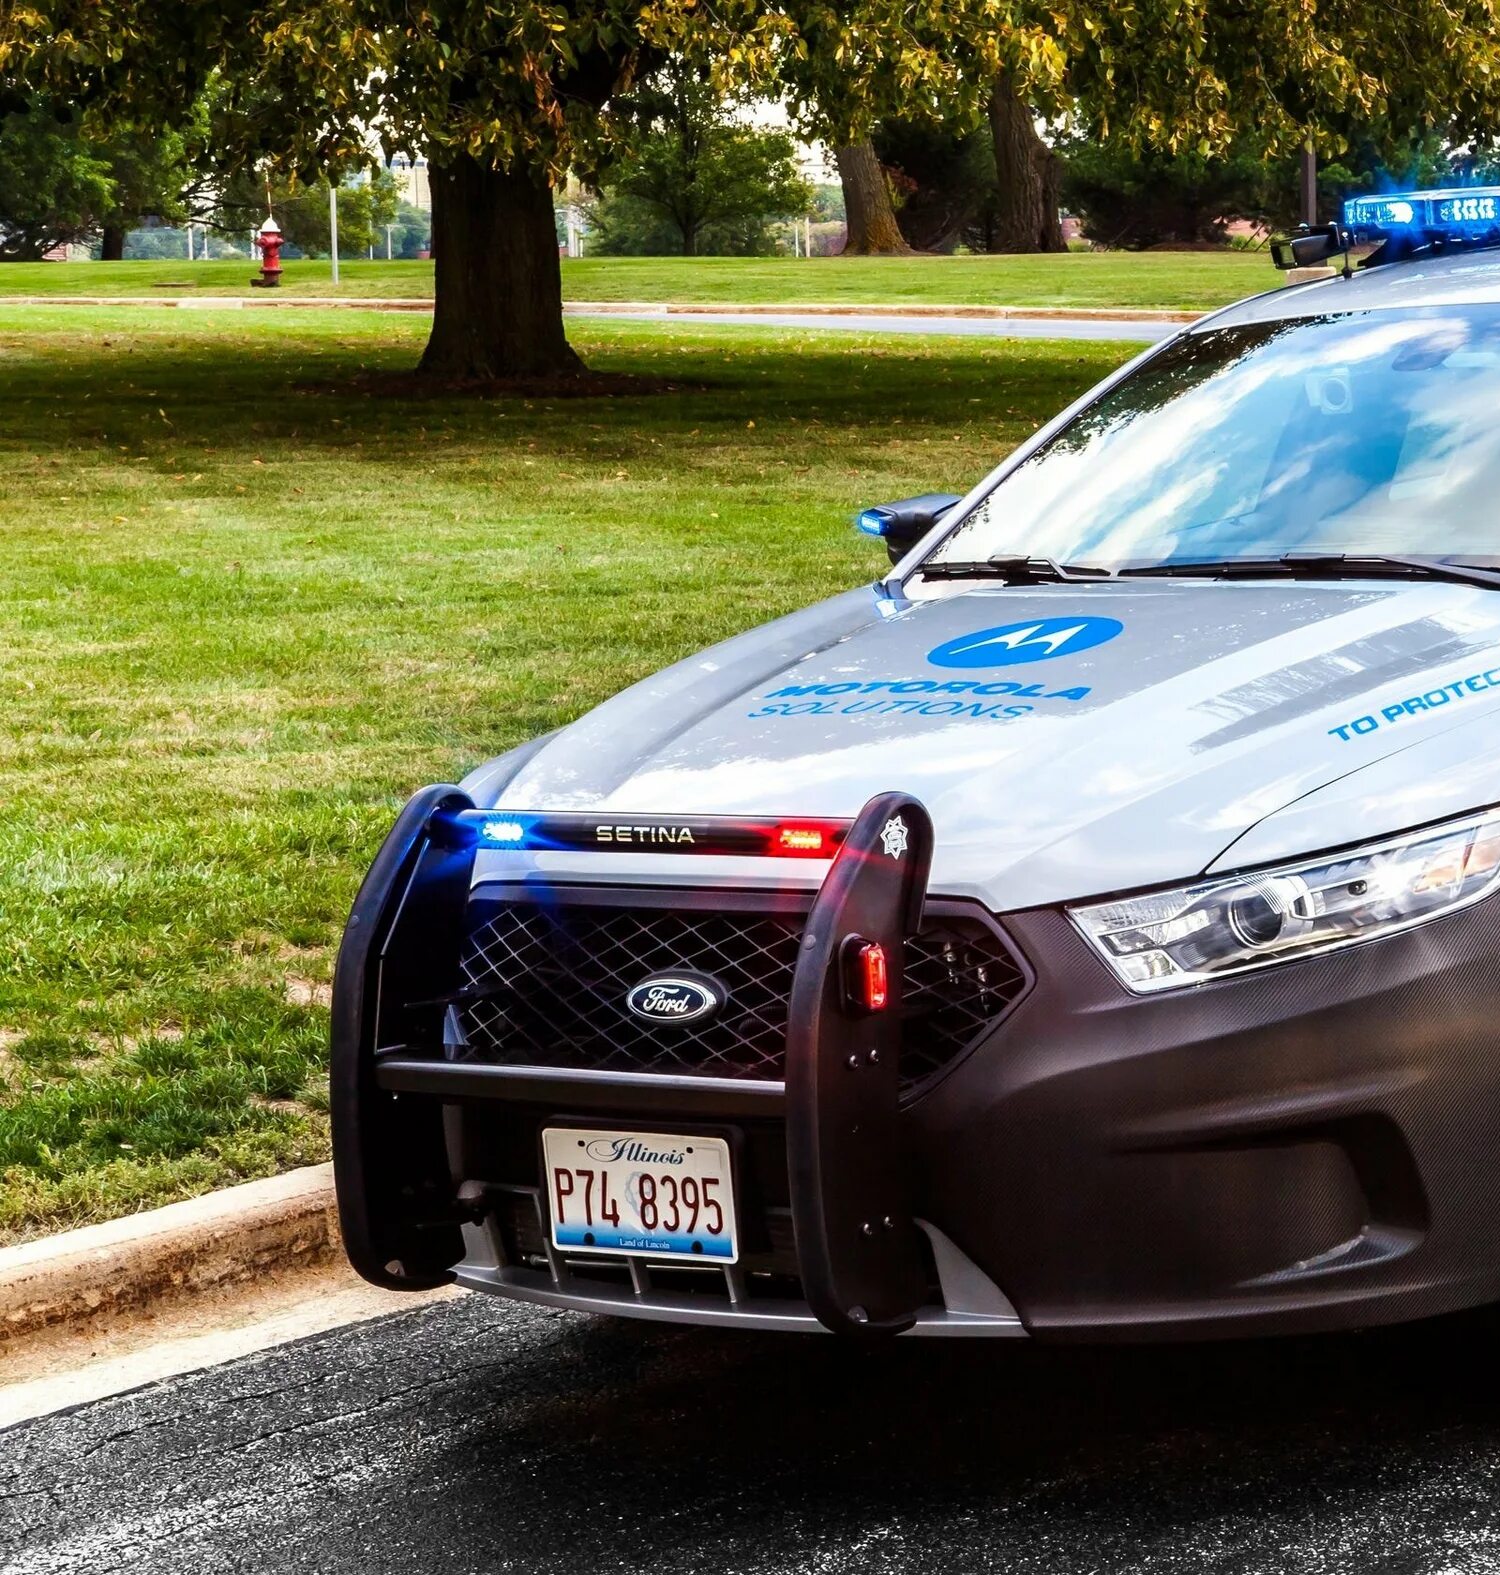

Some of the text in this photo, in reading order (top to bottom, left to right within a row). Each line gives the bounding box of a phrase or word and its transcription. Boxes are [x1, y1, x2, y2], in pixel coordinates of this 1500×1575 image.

[763, 681, 1093, 701] MOTOROLA
[748, 700, 1036, 719] SOLUTIONS
[1328, 715, 1380, 742] TO
[596, 826, 695, 844] SETINA
[643, 986, 690, 1013] Ford
[586, 1137, 687, 1165] Illinois
[554, 1167, 724, 1235] P74 8395
[619, 1238, 671, 1249] Land of Lincoln
